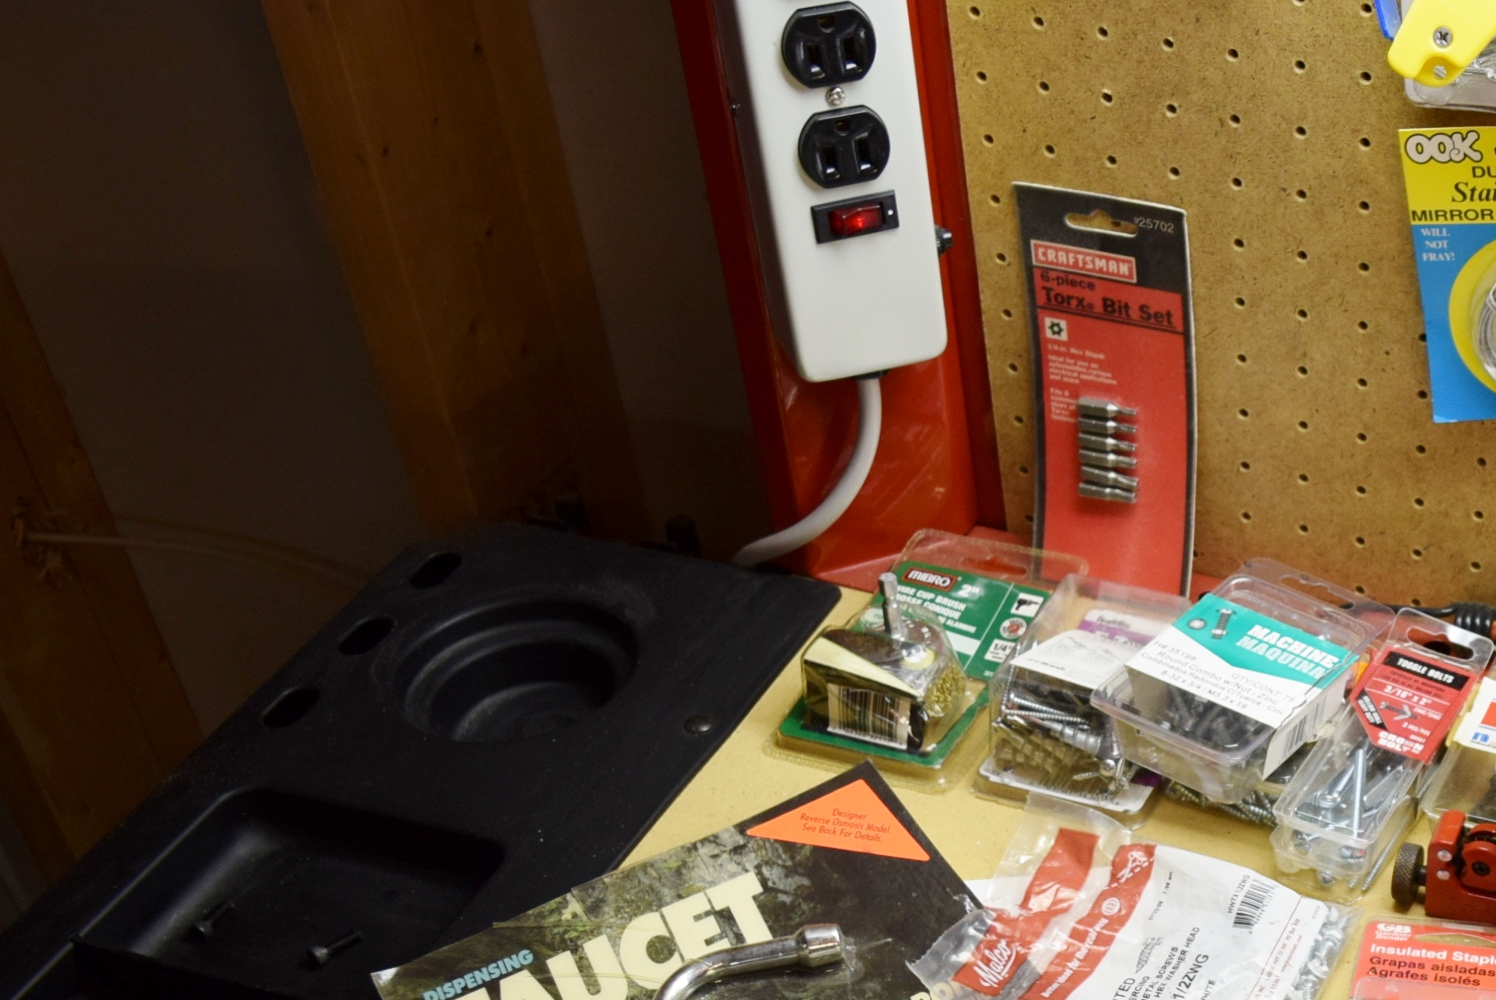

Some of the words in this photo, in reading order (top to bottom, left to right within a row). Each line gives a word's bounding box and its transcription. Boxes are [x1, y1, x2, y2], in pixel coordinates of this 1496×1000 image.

[1406, 130, 1483, 164] OOK
[1411, 208, 1494, 222] MIRROR
[1420, 228, 1450, 237] WILL
[1425, 240, 1448, 249] NOT
[1038, 247, 1130, 276] CRAFTSMAN
[1422, 252, 1455, 261] FRAY!
[1040, 270, 1096, 291] 6-piece
[1102, 297, 1131, 318] Bit
[1139, 304, 1174, 325] Set
[916, 589, 936, 600] CUP
[936, 595, 966, 611] BRUSH
[924, 599, 962, 619] CONIQUE
[1247, 625, 1339, 669] MACHINE
[1156, 651, 1190, 667] Round
[1190, 662, 1224, 682] Combo
[1397, 658, 1428, 674] TOGGLE
[1427, 669, 1455, 683] BOLTS
[1384, 685, 1412, 699] 3/16"
[1378, 731, 1424, 752] CROWN
[800, 812, 831, 826] Reverse
[832, 818, 864, 831] Osmosis
[865, 822, 893, 835] Model.
[832, 808, 868, 821] Designer
[802, 823, 817, 833] See
[818, 826, 838, 836] Back
[839, 828, 852, 838] For
[854, 830, 883, 843] Details.
[1377, 924, 1412, 933] GB
[1371, 944, 1447, 959] Insulated
[973, 939, 1011, 988] Malco
[1155, 983, 1167, 998] HEX
[1166, 950, 1187, 981] WASHER
[1186, 927, 1200, 948] HEAD
[1156, 946, 1179, 979] SCREWS
[1369, 956, 1426, 970] Grapas
[1431, 963, 1496, 977] aisladas
[1367, 967, 1428, 981] Agrafes
[1434, 973, 1481, 986] isolés
